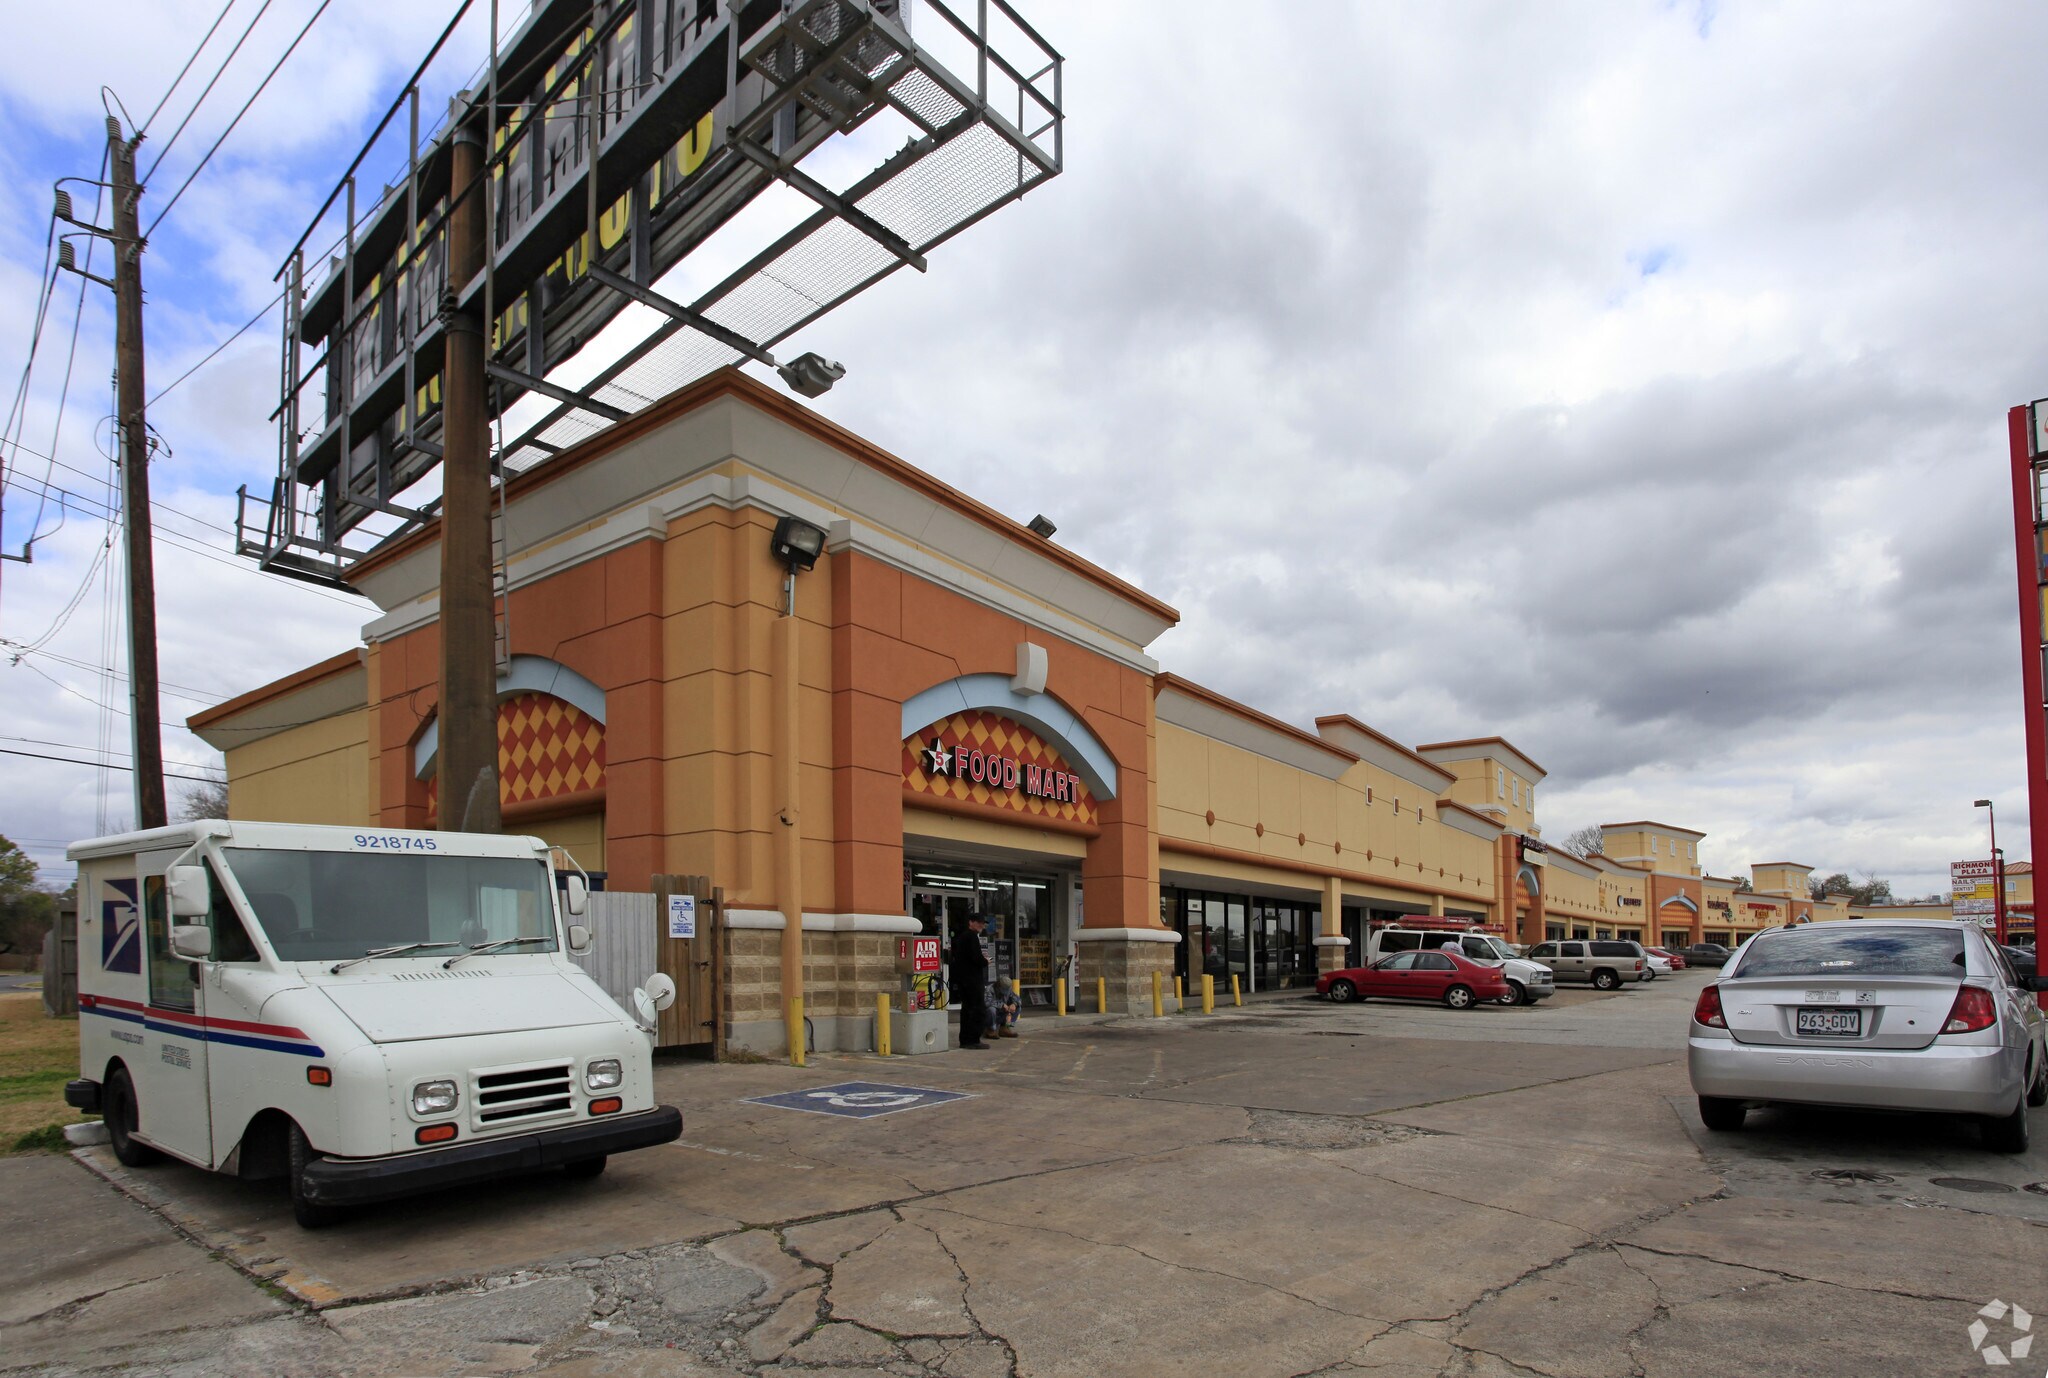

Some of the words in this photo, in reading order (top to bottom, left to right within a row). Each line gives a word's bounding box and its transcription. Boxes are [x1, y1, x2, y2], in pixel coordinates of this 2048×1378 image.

[935, 751, 944, 767] 5
[954, 745, 1017, 789] FOOD
[1027, 763, 1080, 803] MART
[354, 834, 437, 850] 9218745
[1953, 861, 1994, 870] RICHMOND
[1961, 867, 1988, 875] PLAZA
[916, 942, 938, 958] AIR
[1801, 1014, 1826, 1028] 963
[1831, 1015, 1856, 1029] GDV
[1775, 1056, 1873, 1069] SATURN
